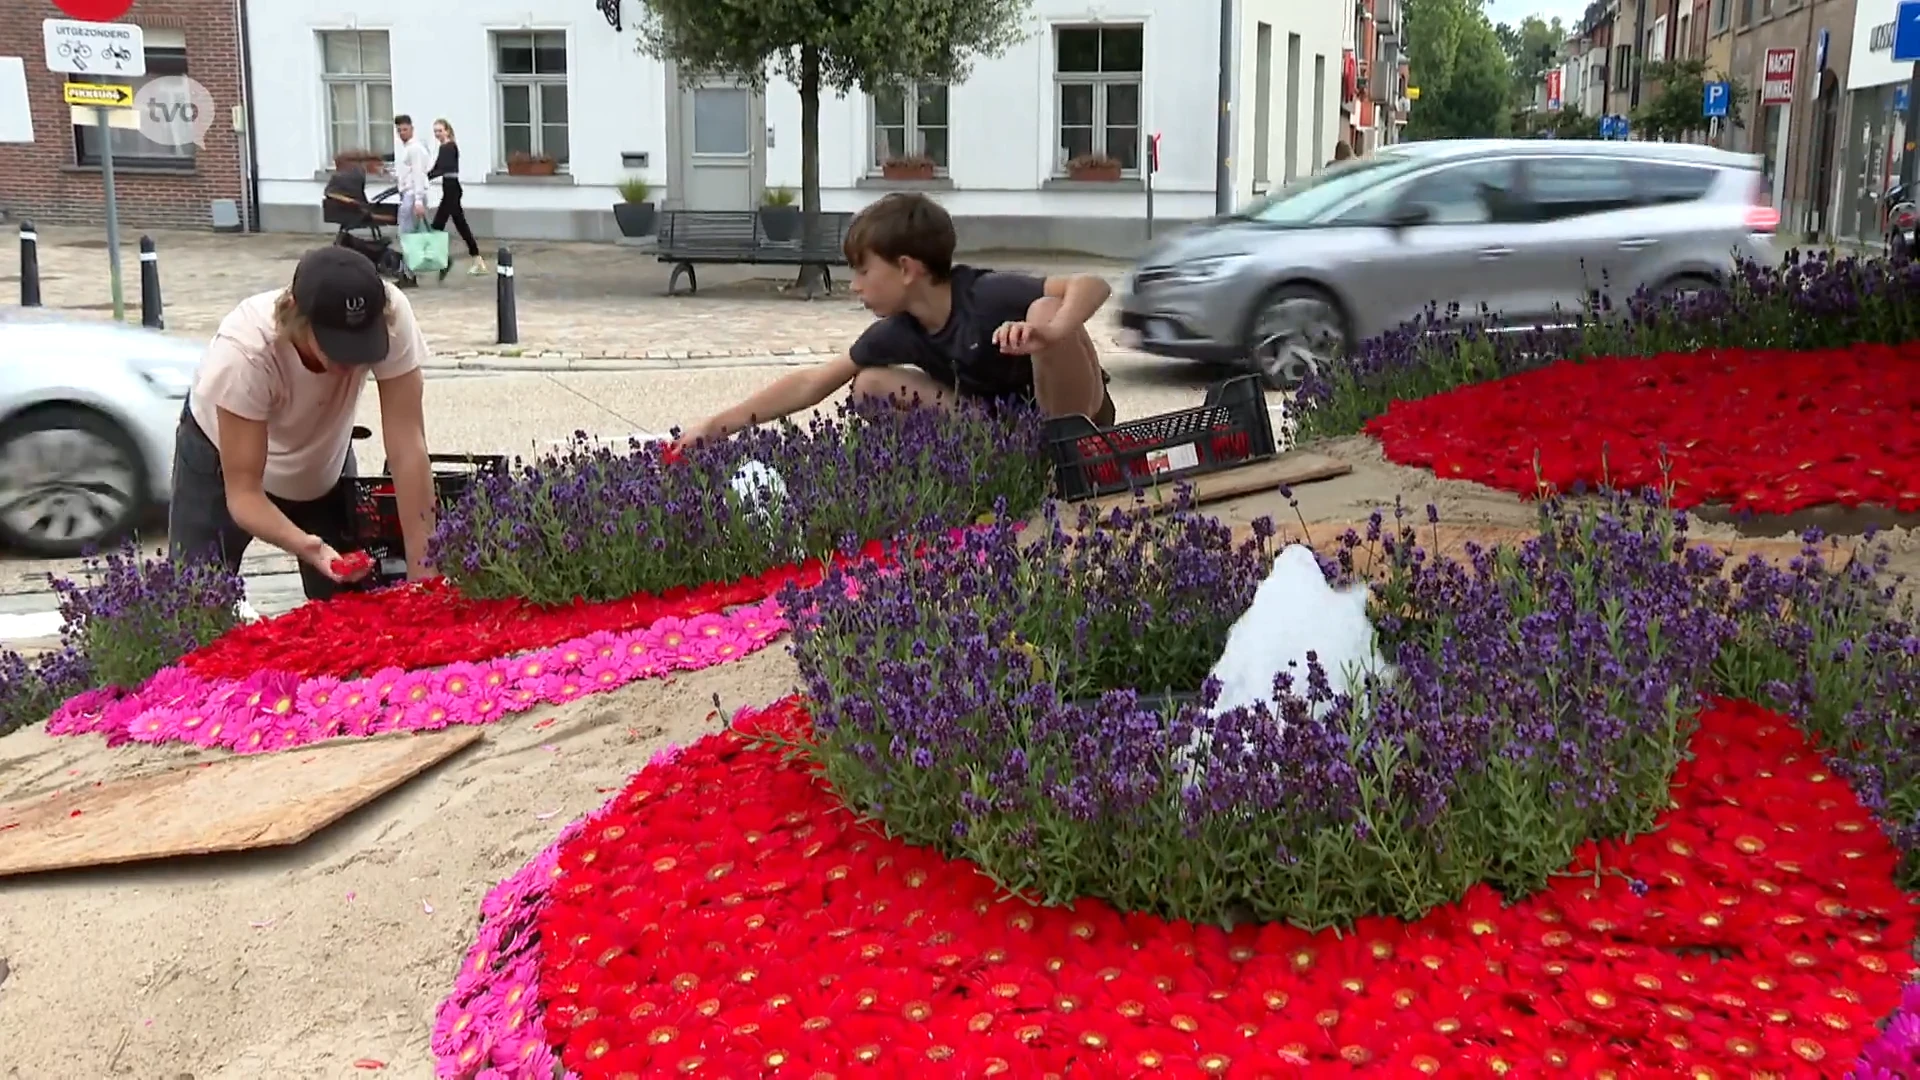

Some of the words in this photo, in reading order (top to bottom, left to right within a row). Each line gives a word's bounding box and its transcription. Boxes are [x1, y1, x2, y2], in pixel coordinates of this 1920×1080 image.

[56, 26, 130, 39] UITGEZONDERD
[1768, 53, 1793, 73] NACHT
[1709, 85, 1723, 104] P
